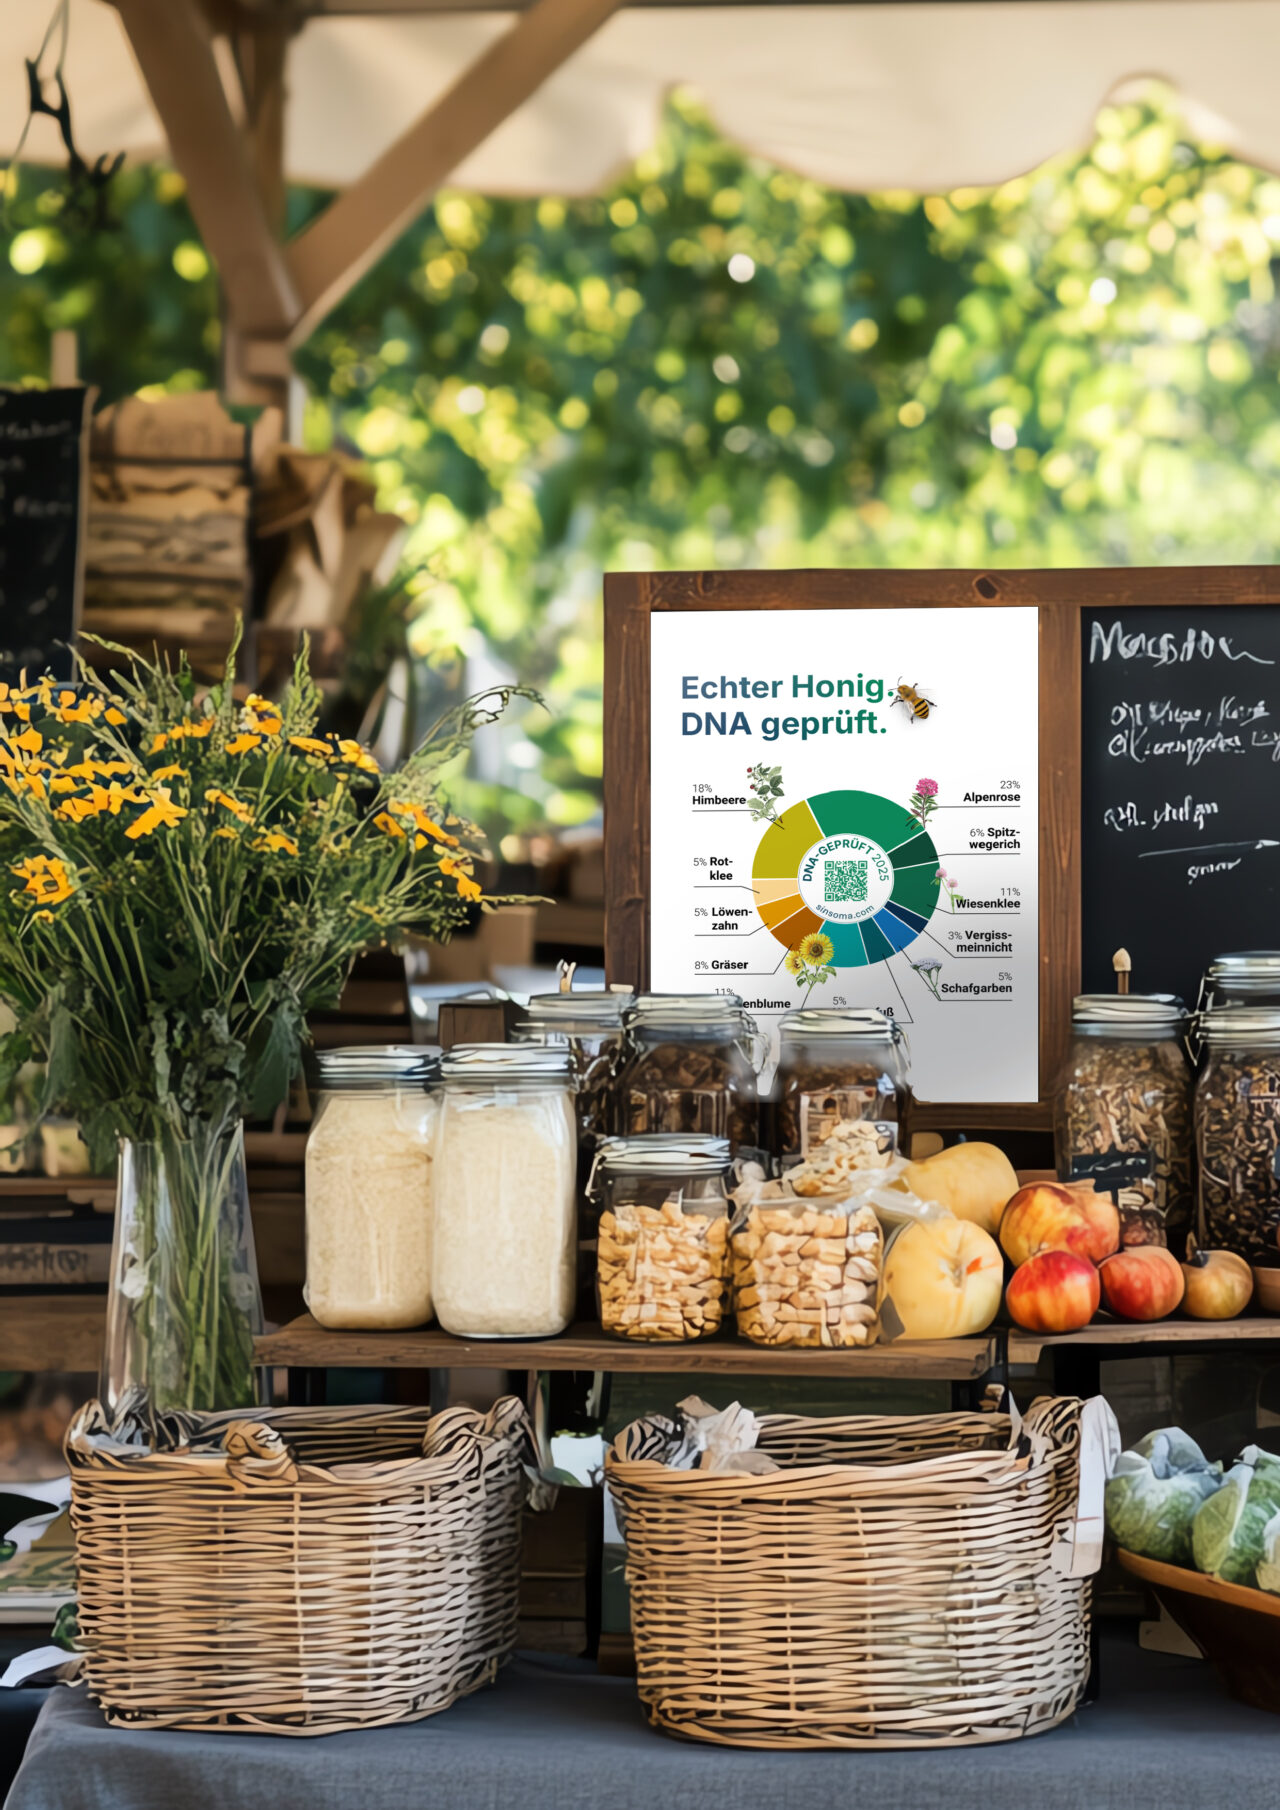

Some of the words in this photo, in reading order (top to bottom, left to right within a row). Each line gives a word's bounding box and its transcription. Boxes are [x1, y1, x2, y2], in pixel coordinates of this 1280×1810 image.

[682, 676, 783, 699] Echter
[792, 672, 895, 704] Honig.
[682, 712, 752, 735] DNA
[761, 706, 887, 741] geprüft.
[692, 783, 713, 794] 18%
[999, 780, 1021, 790] 23%
[693, 795, 746, 804] Himbeere
[963, 793, 1021, 804] Alpenrose
[969, 828, 985, 838] 6%
[987, 827, 1021, 839] Spitz-
[969, 839, 1021, 852] wegerich
[693, 857, 708, 867] 5%
[710, 857, 733, 866] Rot-
[802, 837, 875, 882] DNA-GEPRÜFT
[871, 853, 890, 882] 2025
[710, 870, 732, 880] klee
[1000, 887, 1021, 897] 11%
[955, 899, 1021, 909] Wiesenklee
[694, 907, 709, 917] 5%
[712, 907, 752, 916] Löwen-
[815, 904, 875, 920] sinsoma.com
[712, 921, 738, 930] zahn
[947, 930, 963, 941] 3%
[964, 930, 1013, 942] Vergiss-
[957, 942, 1012, 952] meinnicht
[694, 960, 710, 970] 8%
[712, 960, 748, 969] Gräser
[998, 971, 1013, 981] 5%
[941, 983, 1012, 995] Schafgarben
[742, 998, 791, 1009] enblume
[832, 996, 847, 1006] 5%
